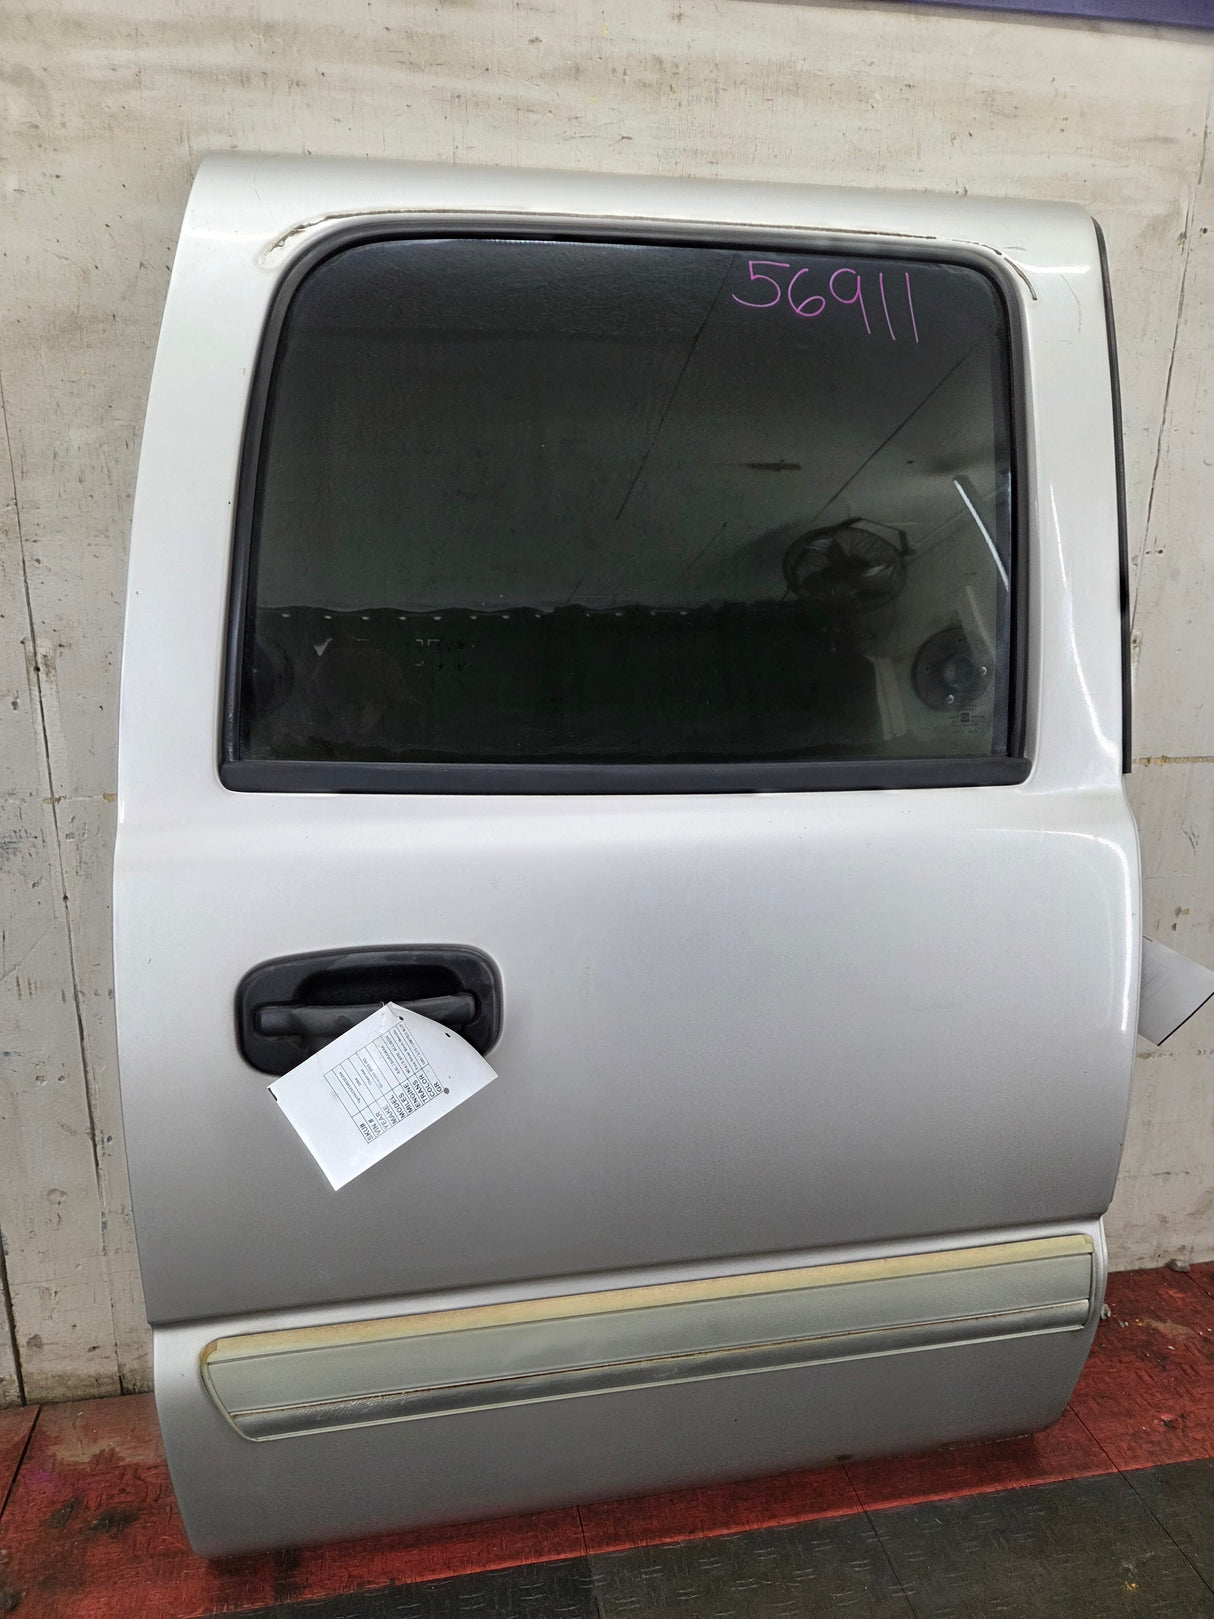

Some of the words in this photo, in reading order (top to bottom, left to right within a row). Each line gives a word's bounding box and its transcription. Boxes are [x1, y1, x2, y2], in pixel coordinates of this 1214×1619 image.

[731, 259, 920, 344] 56911
[402, 1082, 421, 1107] ENGINE
[411, 1079, 429, 1102] TRANS
[417, 1073, 436, 1097] COLOR
[432, 1081, 442, 1092] GR
[387, 1094, 406, 1118] MODEL
[398, 1092, 414, 1112] MILES
[375, 1110, 389, 1129] YEAR
[381, 1104, 397, 1124] MAKE
[359, 1122, 374, 1141] SKU#
[371, 1122, 381, 1134] VIN
